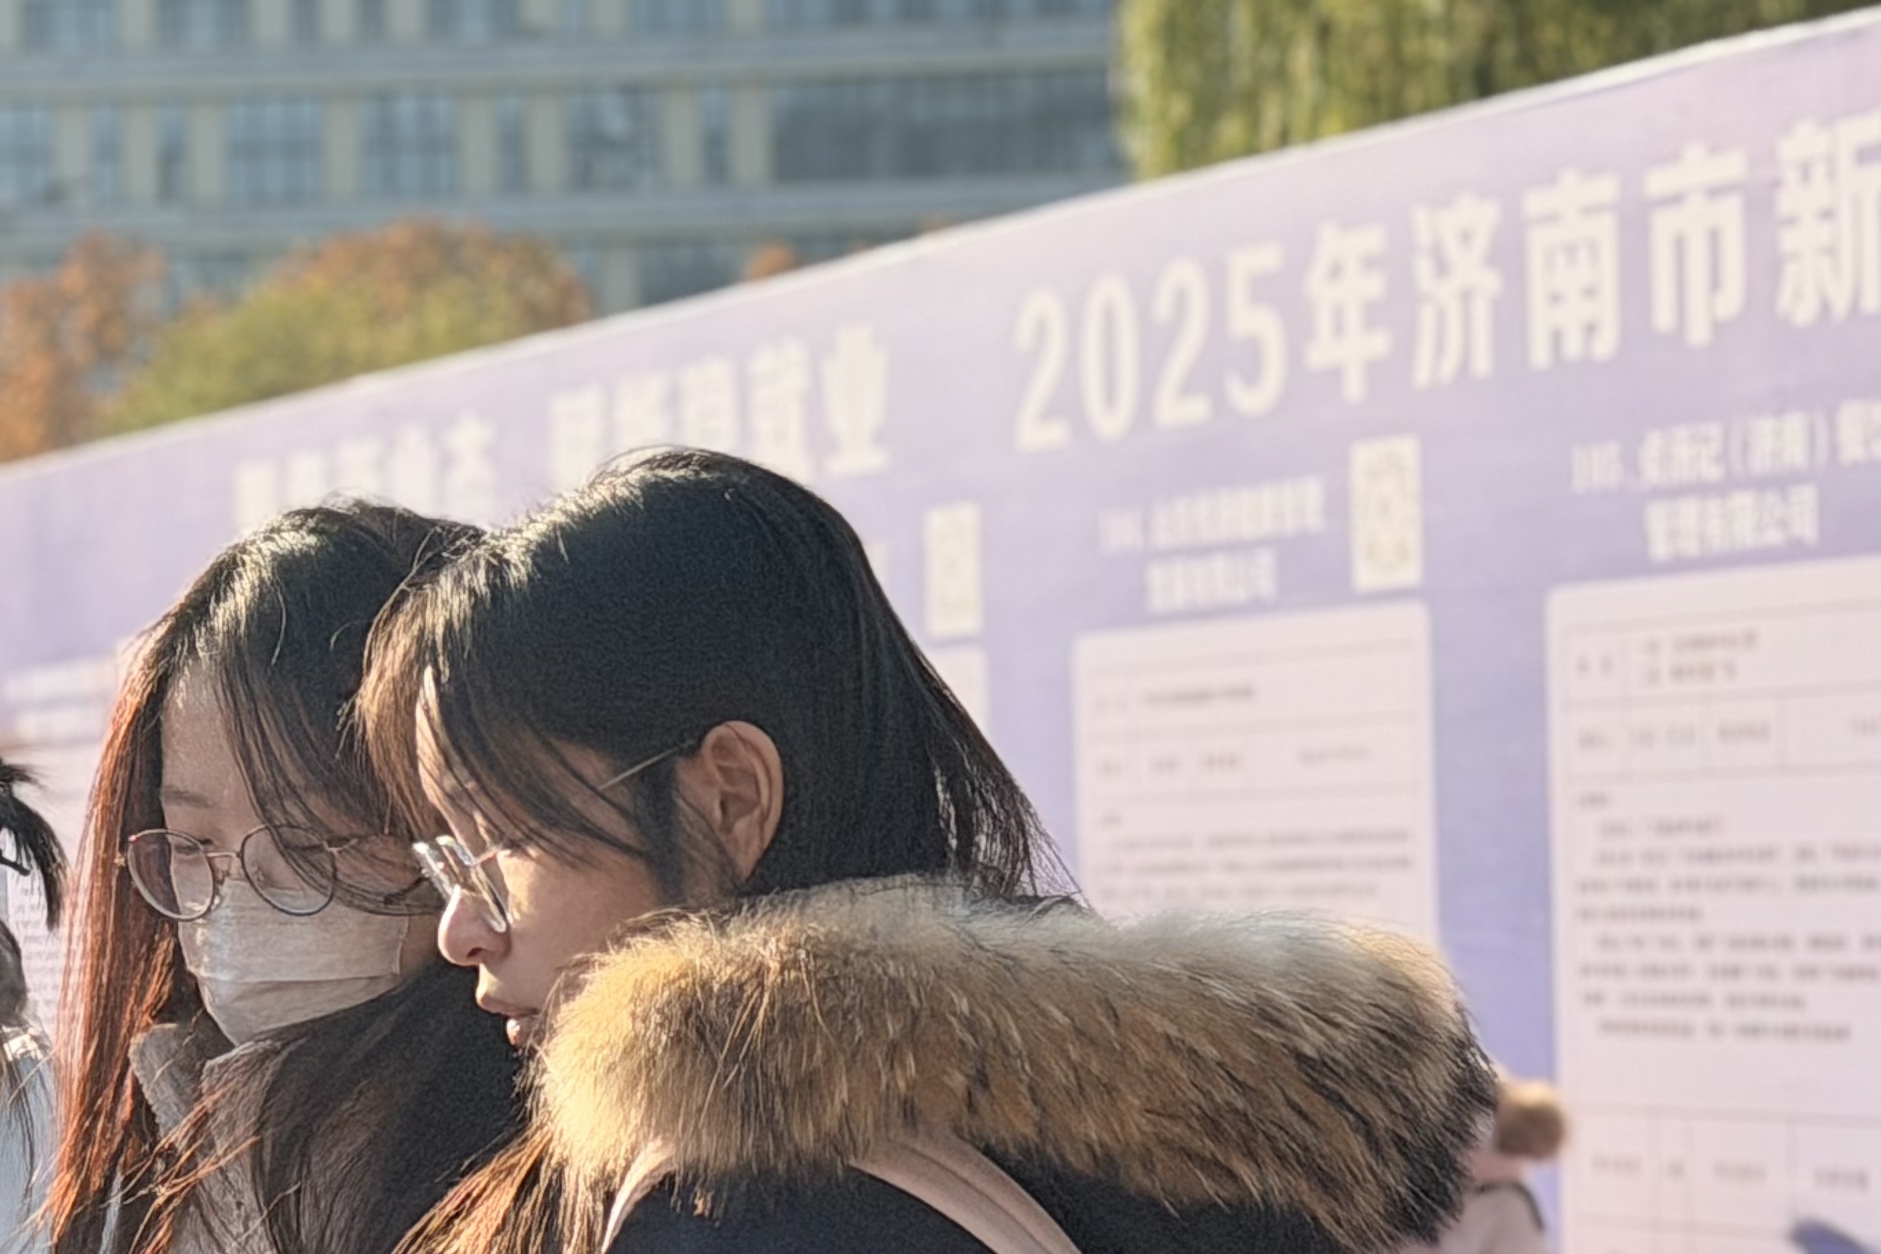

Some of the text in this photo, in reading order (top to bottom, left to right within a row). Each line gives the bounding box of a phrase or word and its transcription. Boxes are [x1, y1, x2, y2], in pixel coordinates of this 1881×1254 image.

[1014, 109, 1881, 452] 2025年济南市新
